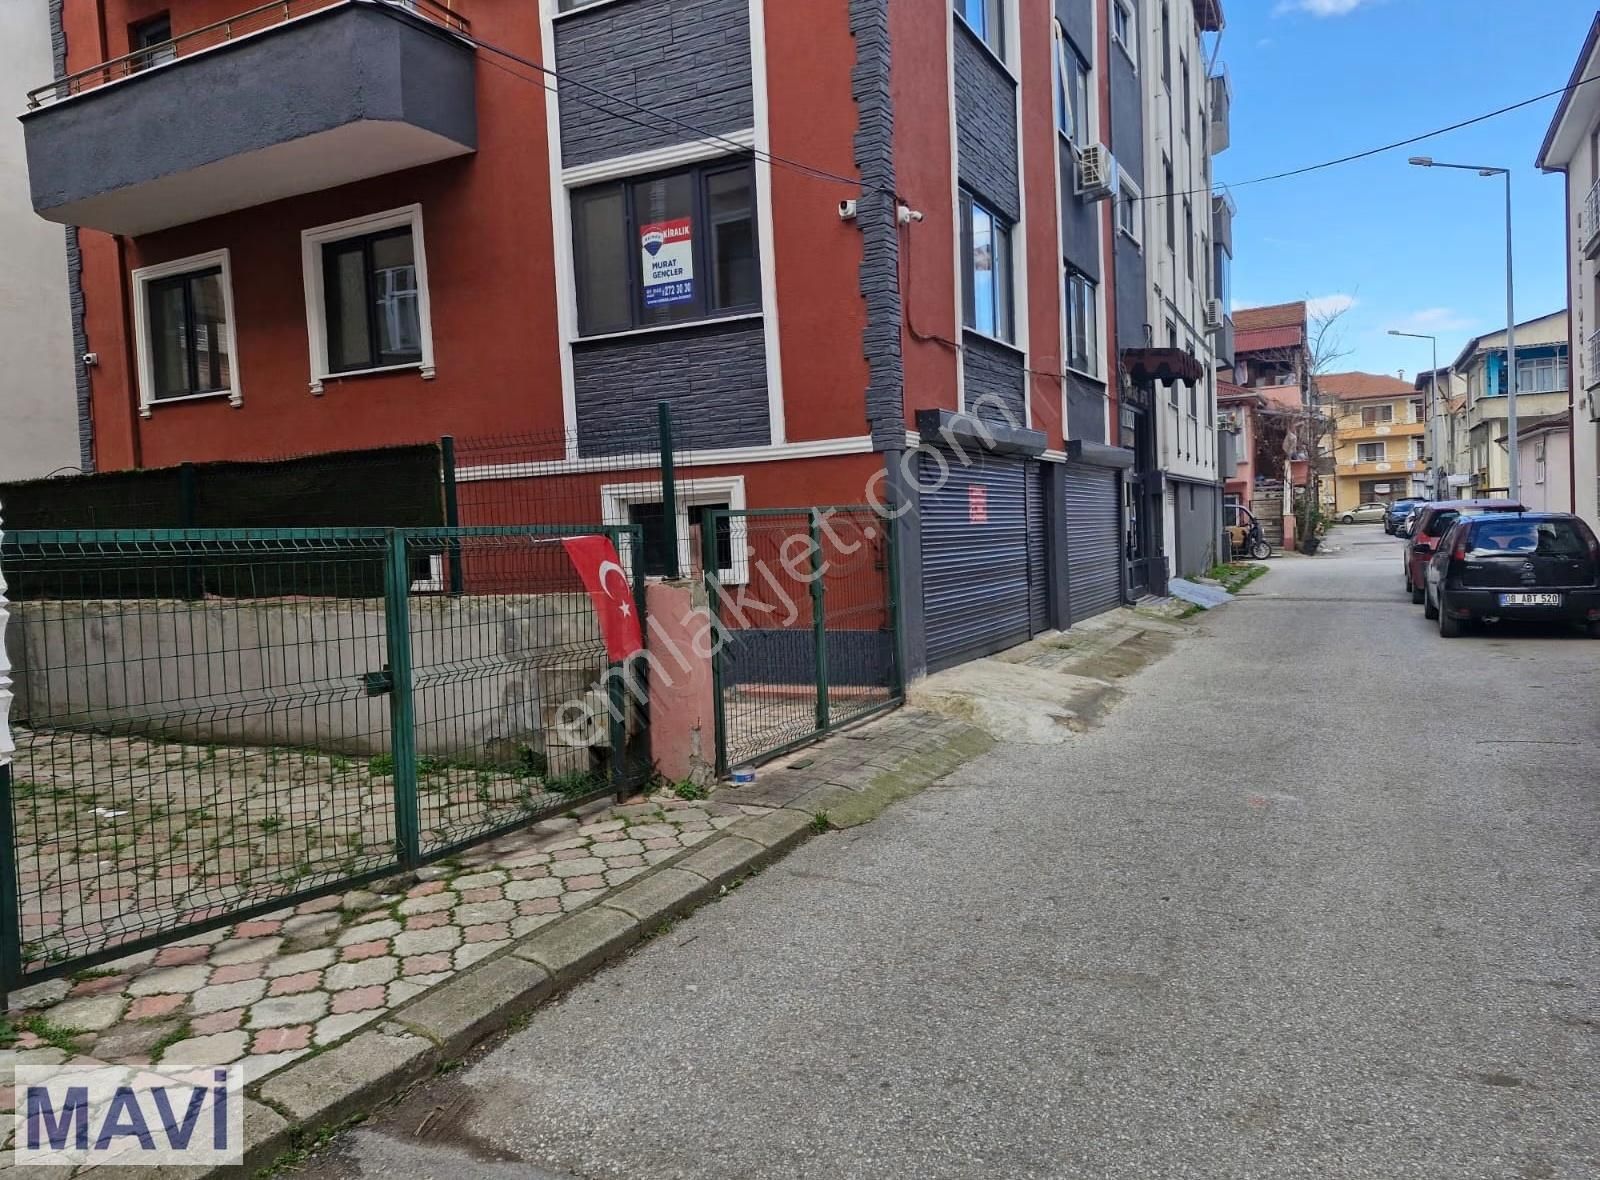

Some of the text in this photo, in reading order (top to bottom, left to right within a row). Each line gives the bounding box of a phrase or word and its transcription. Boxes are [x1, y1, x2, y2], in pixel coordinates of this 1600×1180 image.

[663, 226, 690, 238] KİRALIK
[652, 259, 677, 270] MURAT
[652, 268, 683, 280] GENÇLER
[1522, 594, 1537, 603] ABT
[1541, 594, 1558, 603] 520
